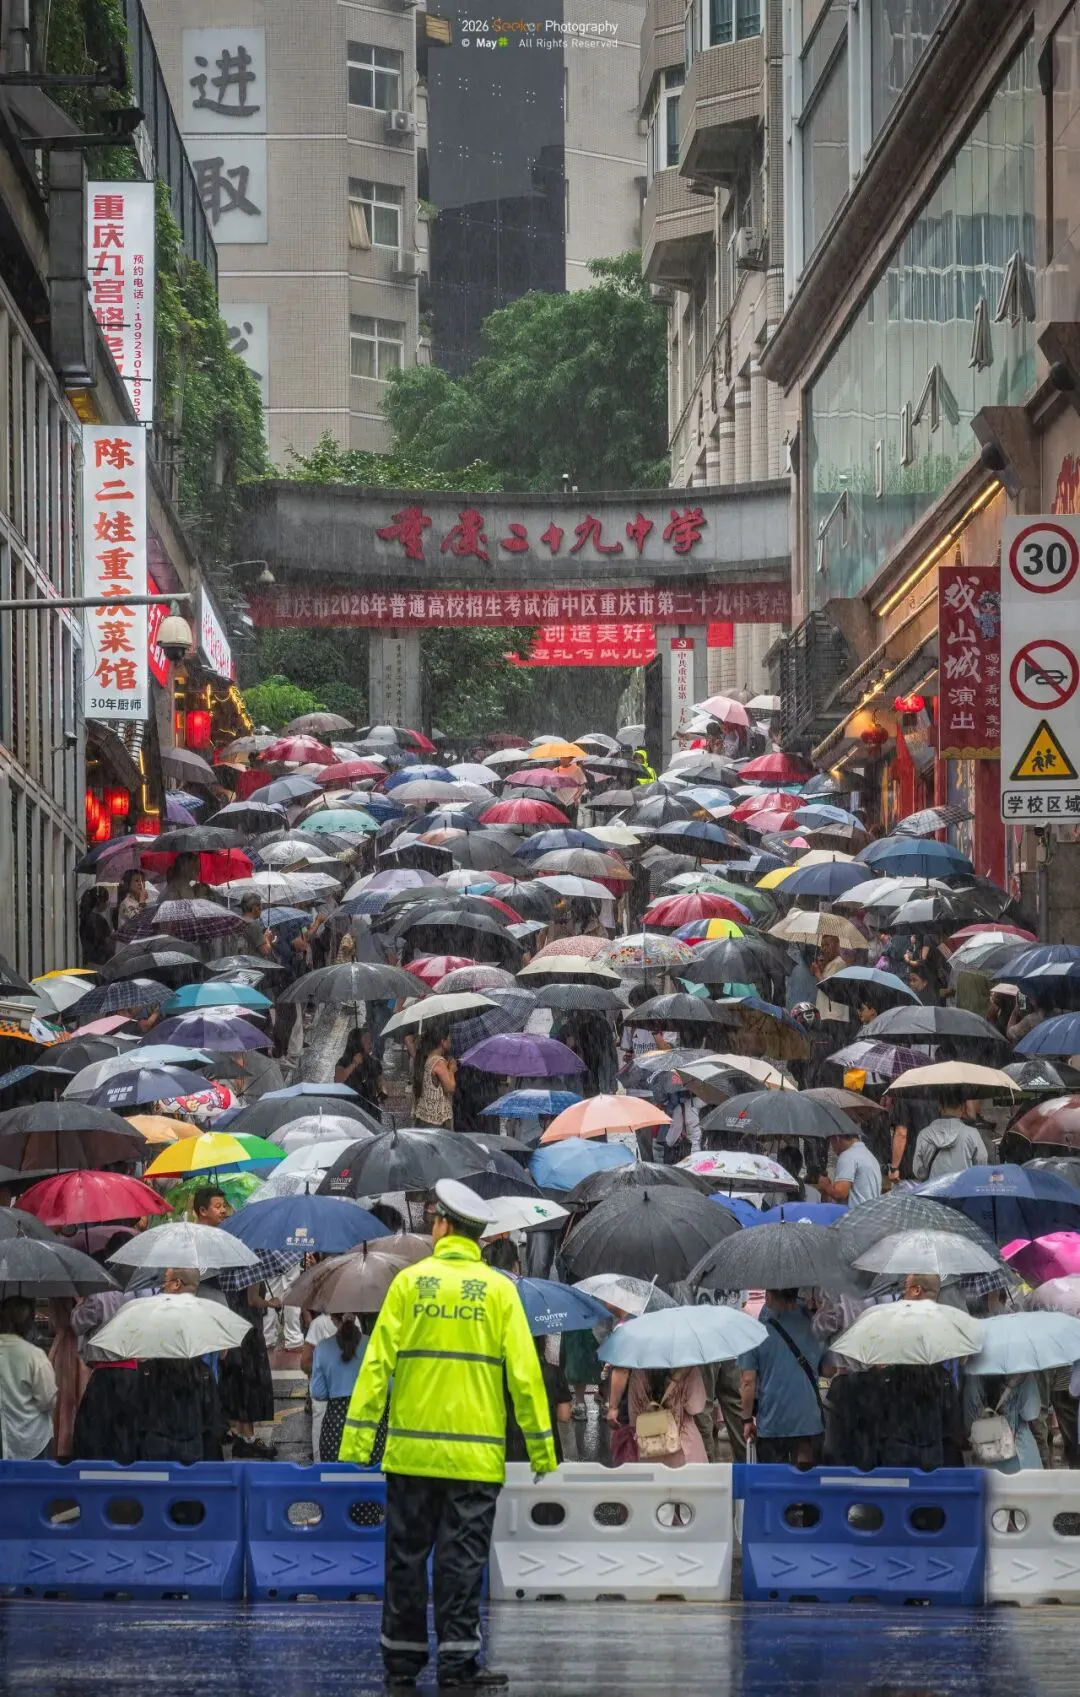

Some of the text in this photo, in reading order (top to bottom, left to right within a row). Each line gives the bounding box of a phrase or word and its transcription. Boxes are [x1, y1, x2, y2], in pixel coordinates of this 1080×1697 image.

[93, 438, 138, 691] 陈二娃重庆菜馆
[1022, 542, 1067, 576] 30
[543, 624, 656, 643] 创造美好
[90, 697, 142, 712] 30年厨师
[1007, 794, 1080, 814] 学校区域
[415, 1276, 487, 1302] 警察
[413, 1303, 486, 1322] POLICE
[534, 1312, 568, 1322] COUNTRY
